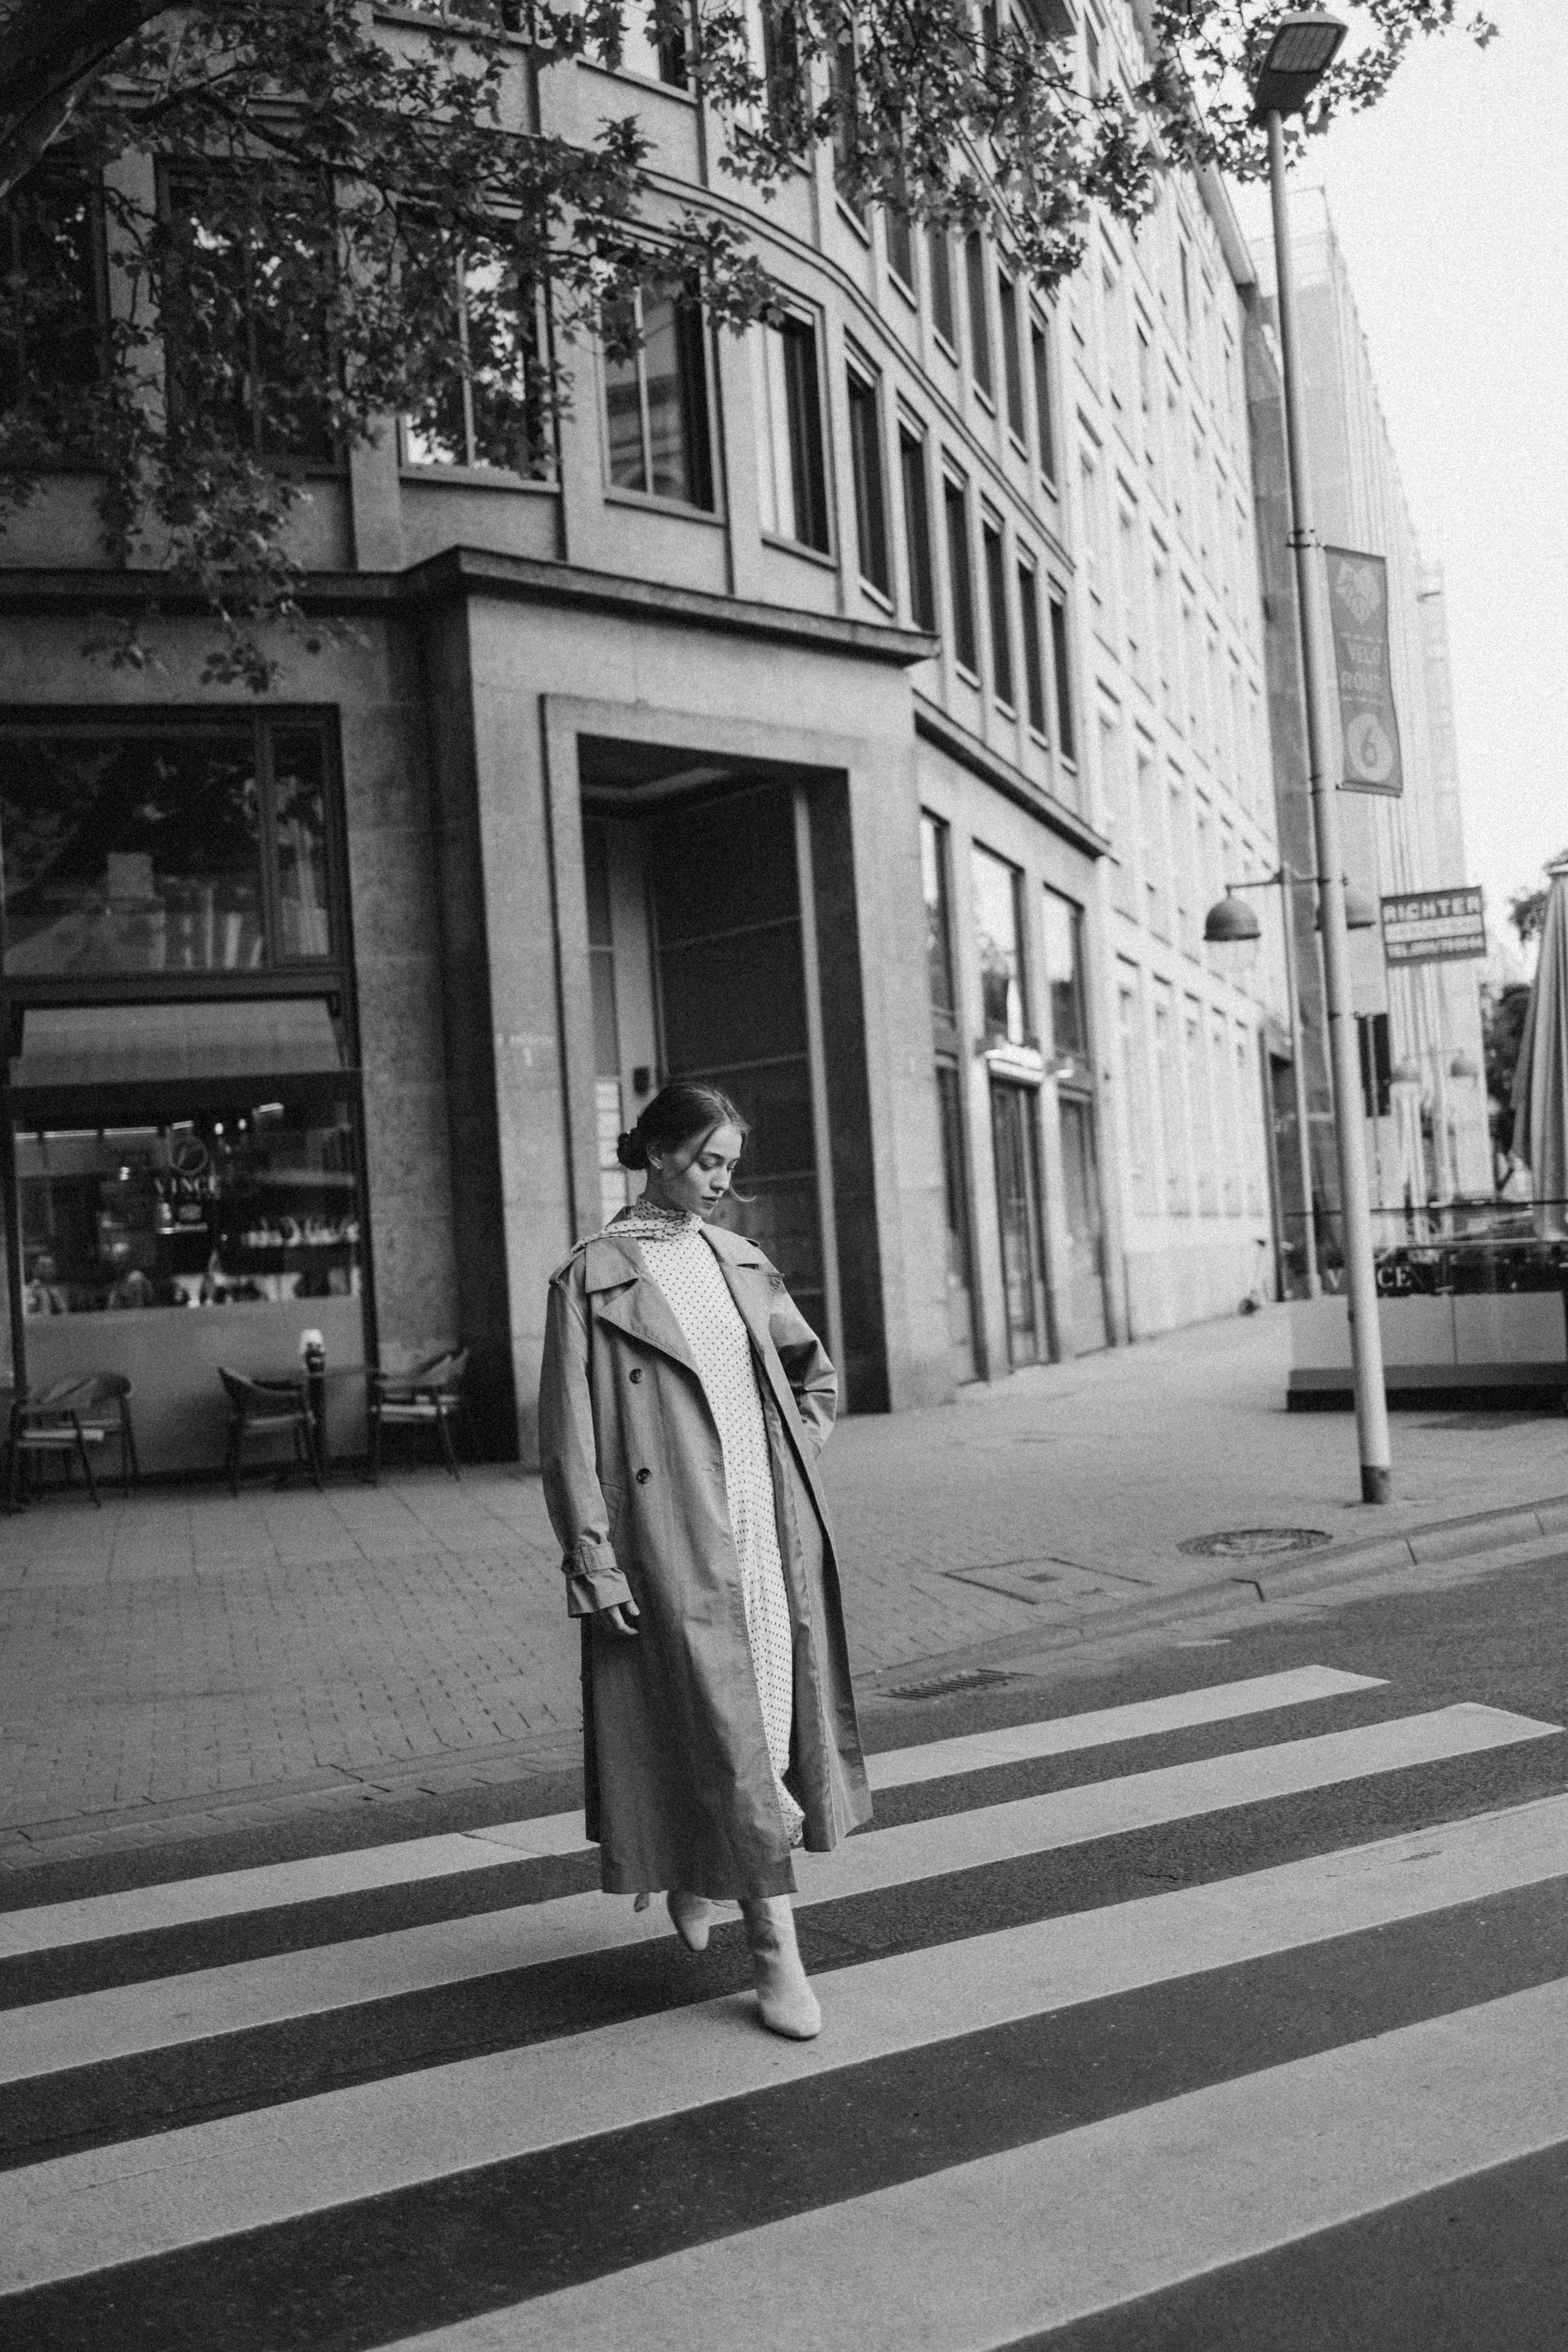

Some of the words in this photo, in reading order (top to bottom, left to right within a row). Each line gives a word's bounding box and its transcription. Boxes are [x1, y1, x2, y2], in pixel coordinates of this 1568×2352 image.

[1361, 726, 1378, 768] 6
[1382, 895, 1481, 922] RICHTER
[1325, 1265, 1411, 1288] VCE
